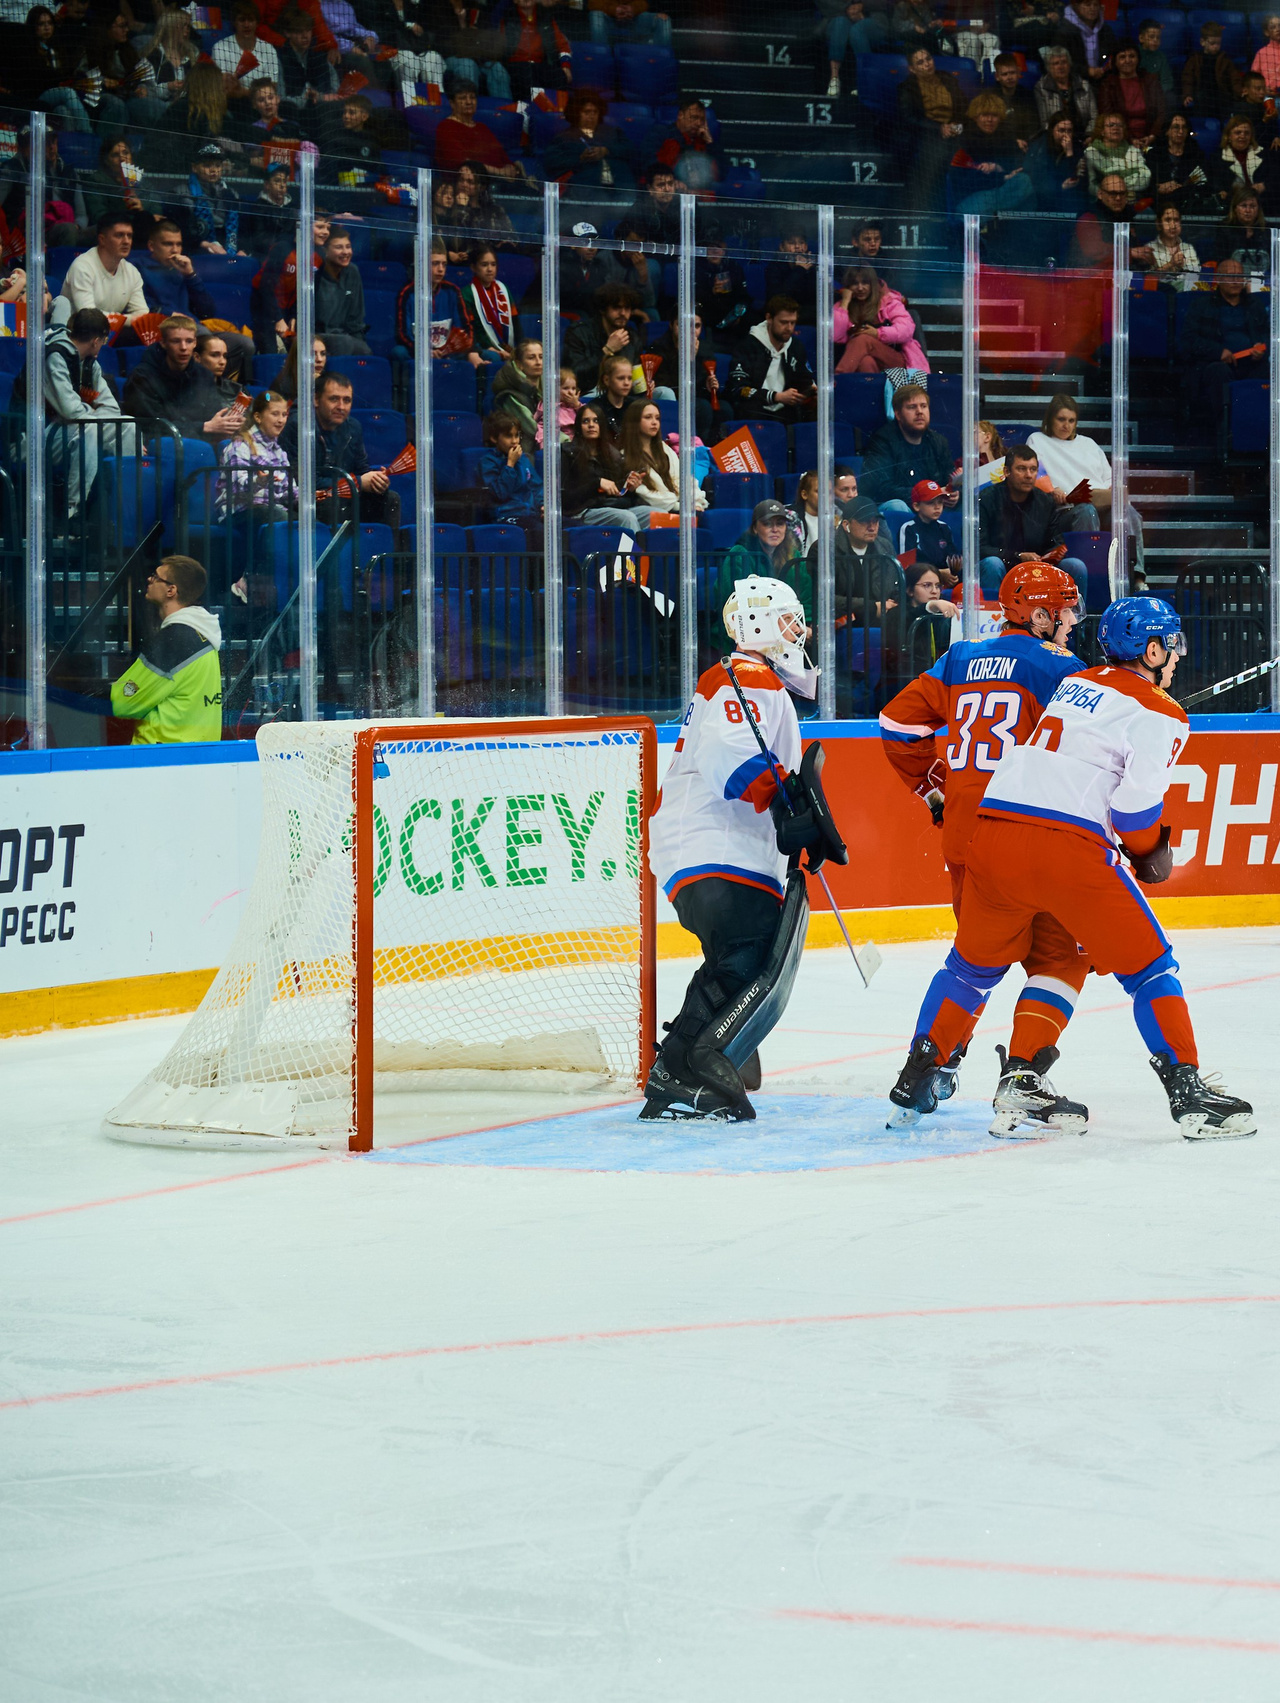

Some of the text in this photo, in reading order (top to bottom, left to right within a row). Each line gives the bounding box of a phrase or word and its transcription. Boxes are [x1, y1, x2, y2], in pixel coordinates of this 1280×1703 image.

[764, 45, 791, 66] 14
[805, 103, 832, 125] 13
[852, 161, 878, 184] 12
[898, 225, 920, 248] 11
[965, 657, 1018, 681] KORZIN
[947, 690, 1022, 772] 33
[714, 982, 760, 1039] SUPREME
